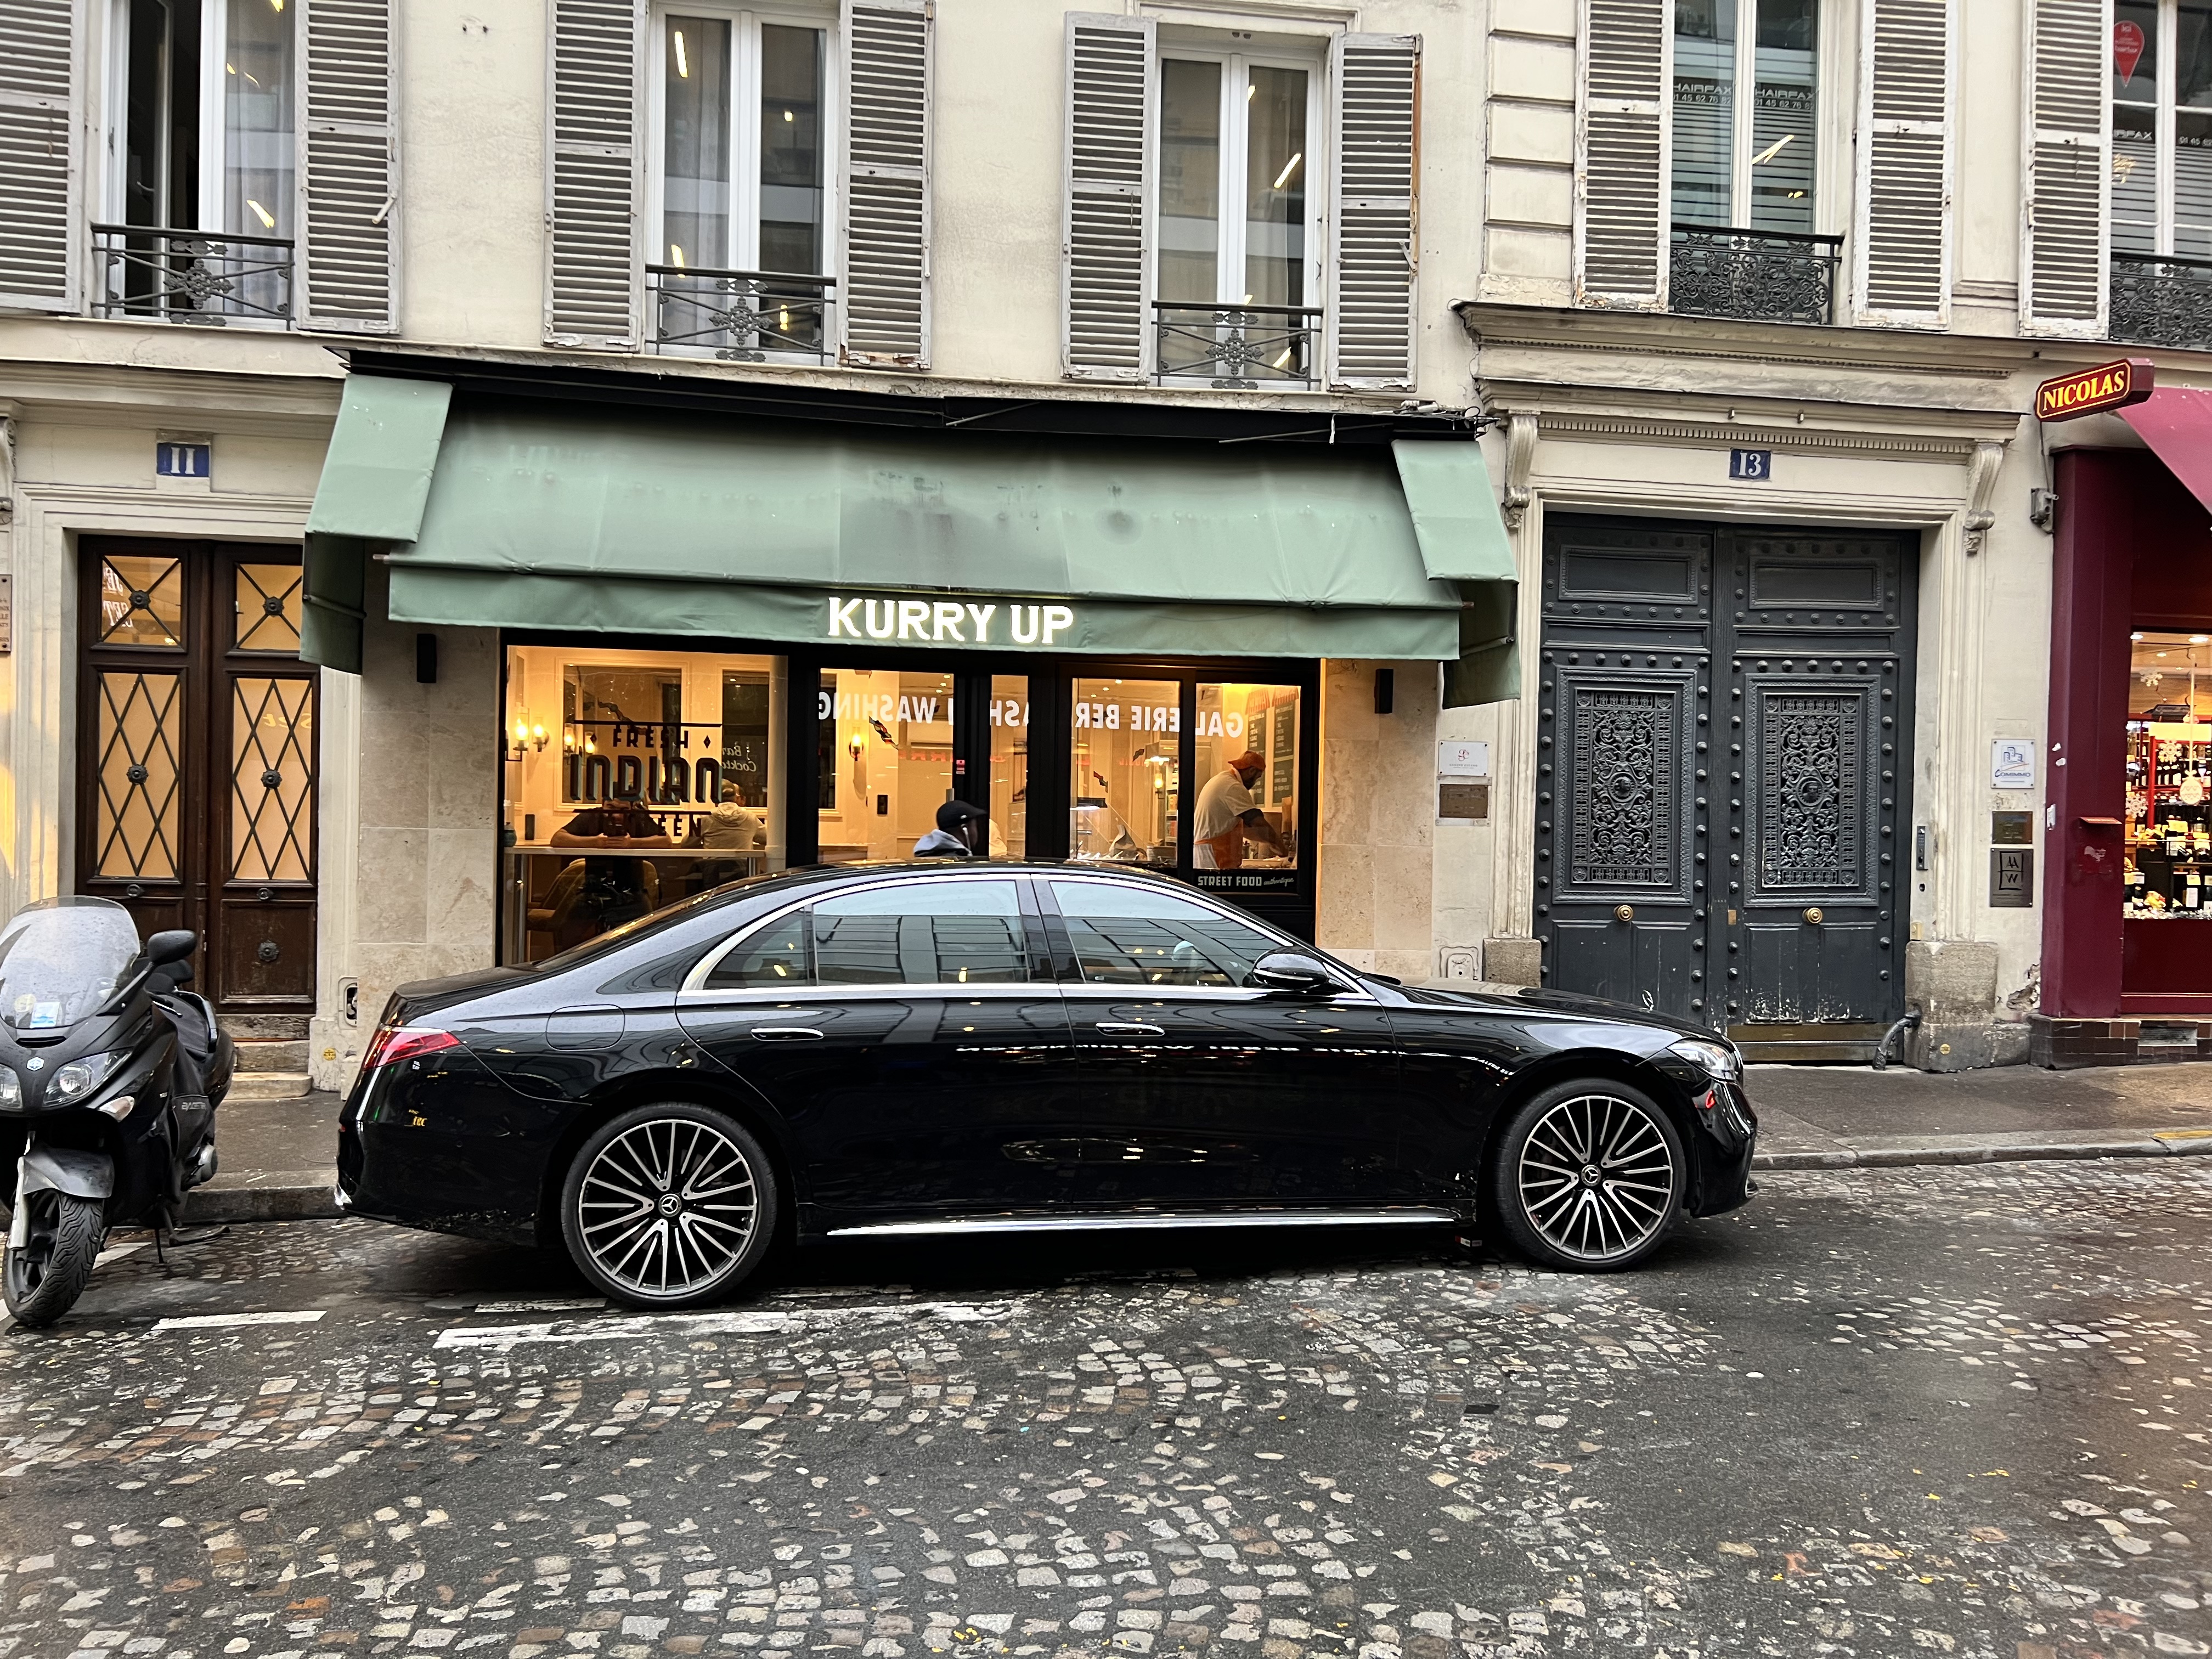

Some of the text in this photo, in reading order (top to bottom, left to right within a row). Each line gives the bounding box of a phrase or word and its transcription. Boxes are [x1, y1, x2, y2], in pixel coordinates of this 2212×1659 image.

[1681, 94, 1692, 102] 45
[1695, 94, 1706, 103] 62
[1755, 88, 1815, 100] HAIRFAX
[2042, 370, 2125, 412] NICOLAS
[171, 447, 195, 475] 11
[1739, 452, 1762, 476] 13
[828, 597, 1074, 644] KURRY UP
[613, 727, 689, 749] FRESH
[569, 754, 723, 803] INDIAN
[1198, 876, 1232, 887] STREET
[1236, 876, 1262, 887] FOOD
